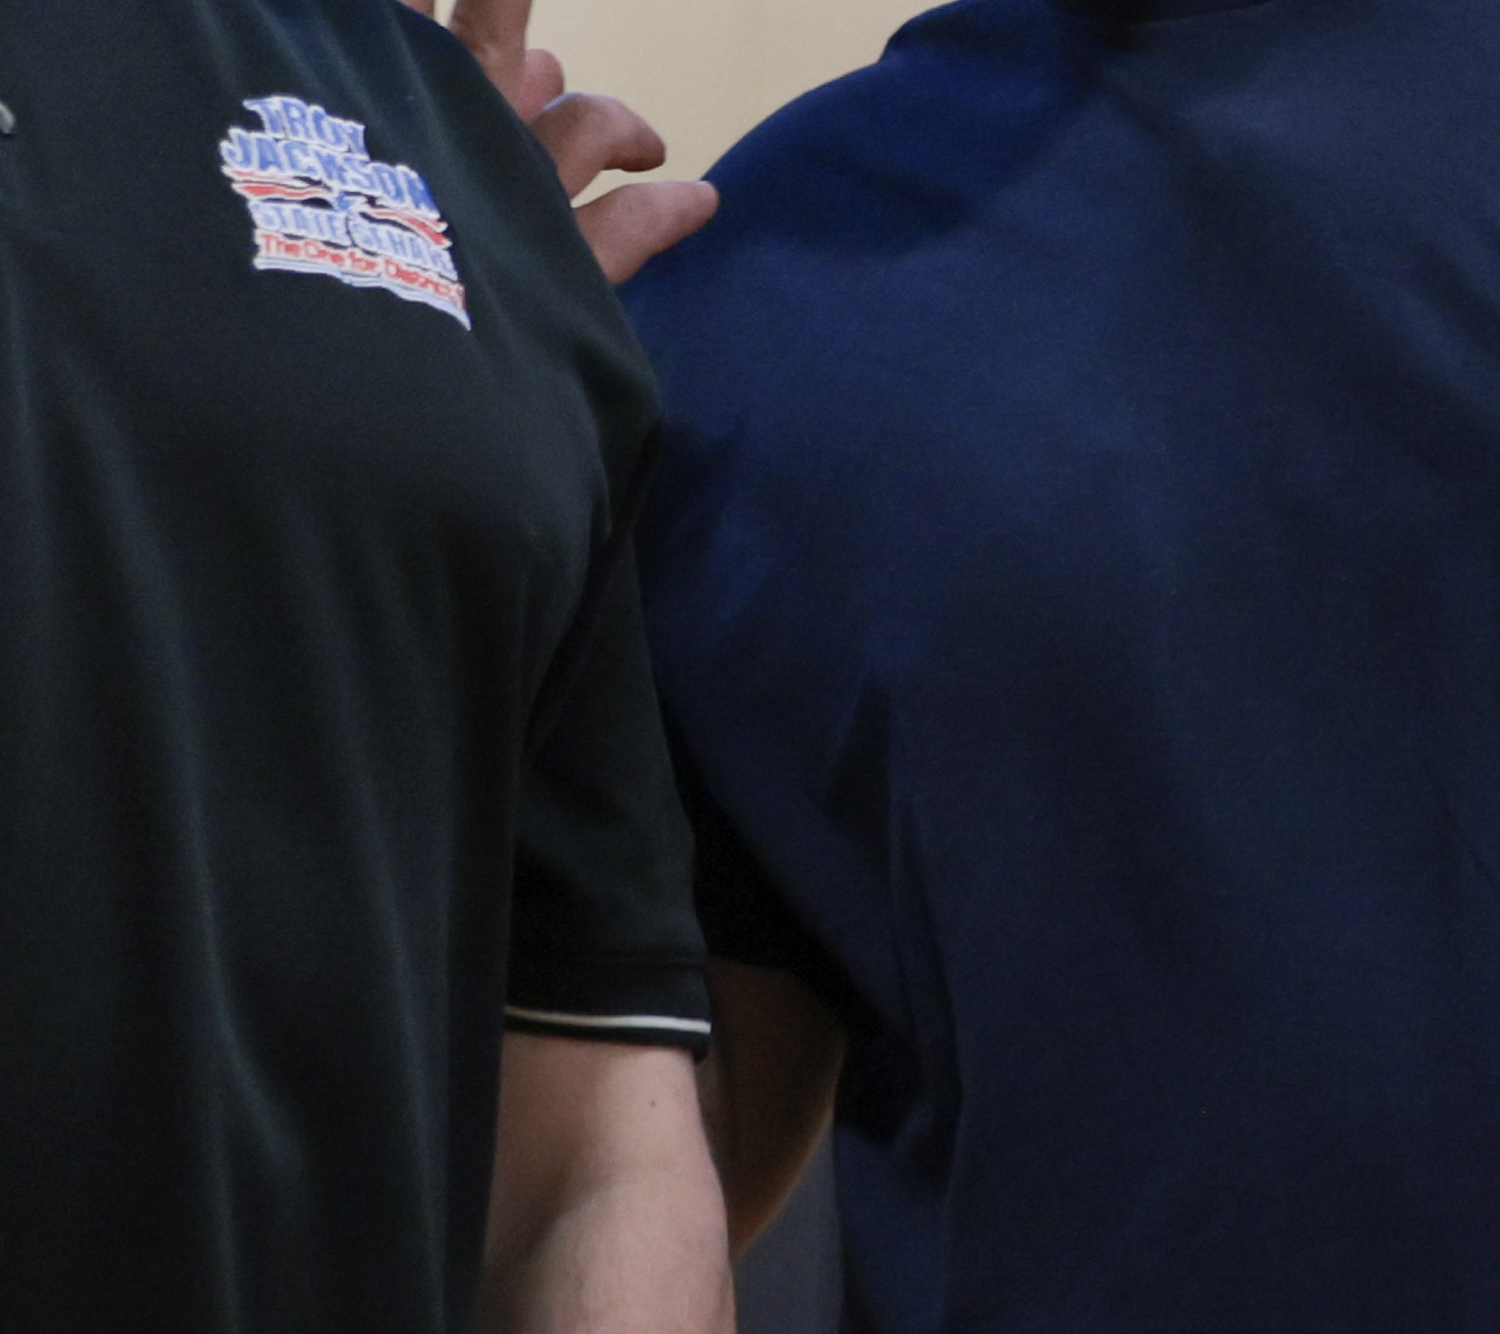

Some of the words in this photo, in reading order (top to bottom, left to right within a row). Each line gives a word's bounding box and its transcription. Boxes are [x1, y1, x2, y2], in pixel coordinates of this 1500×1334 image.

[243, 95, 370, 160] TROY
[220, 127, 441, 219] JACKSON
[249, 200, 352, 247] STATE
